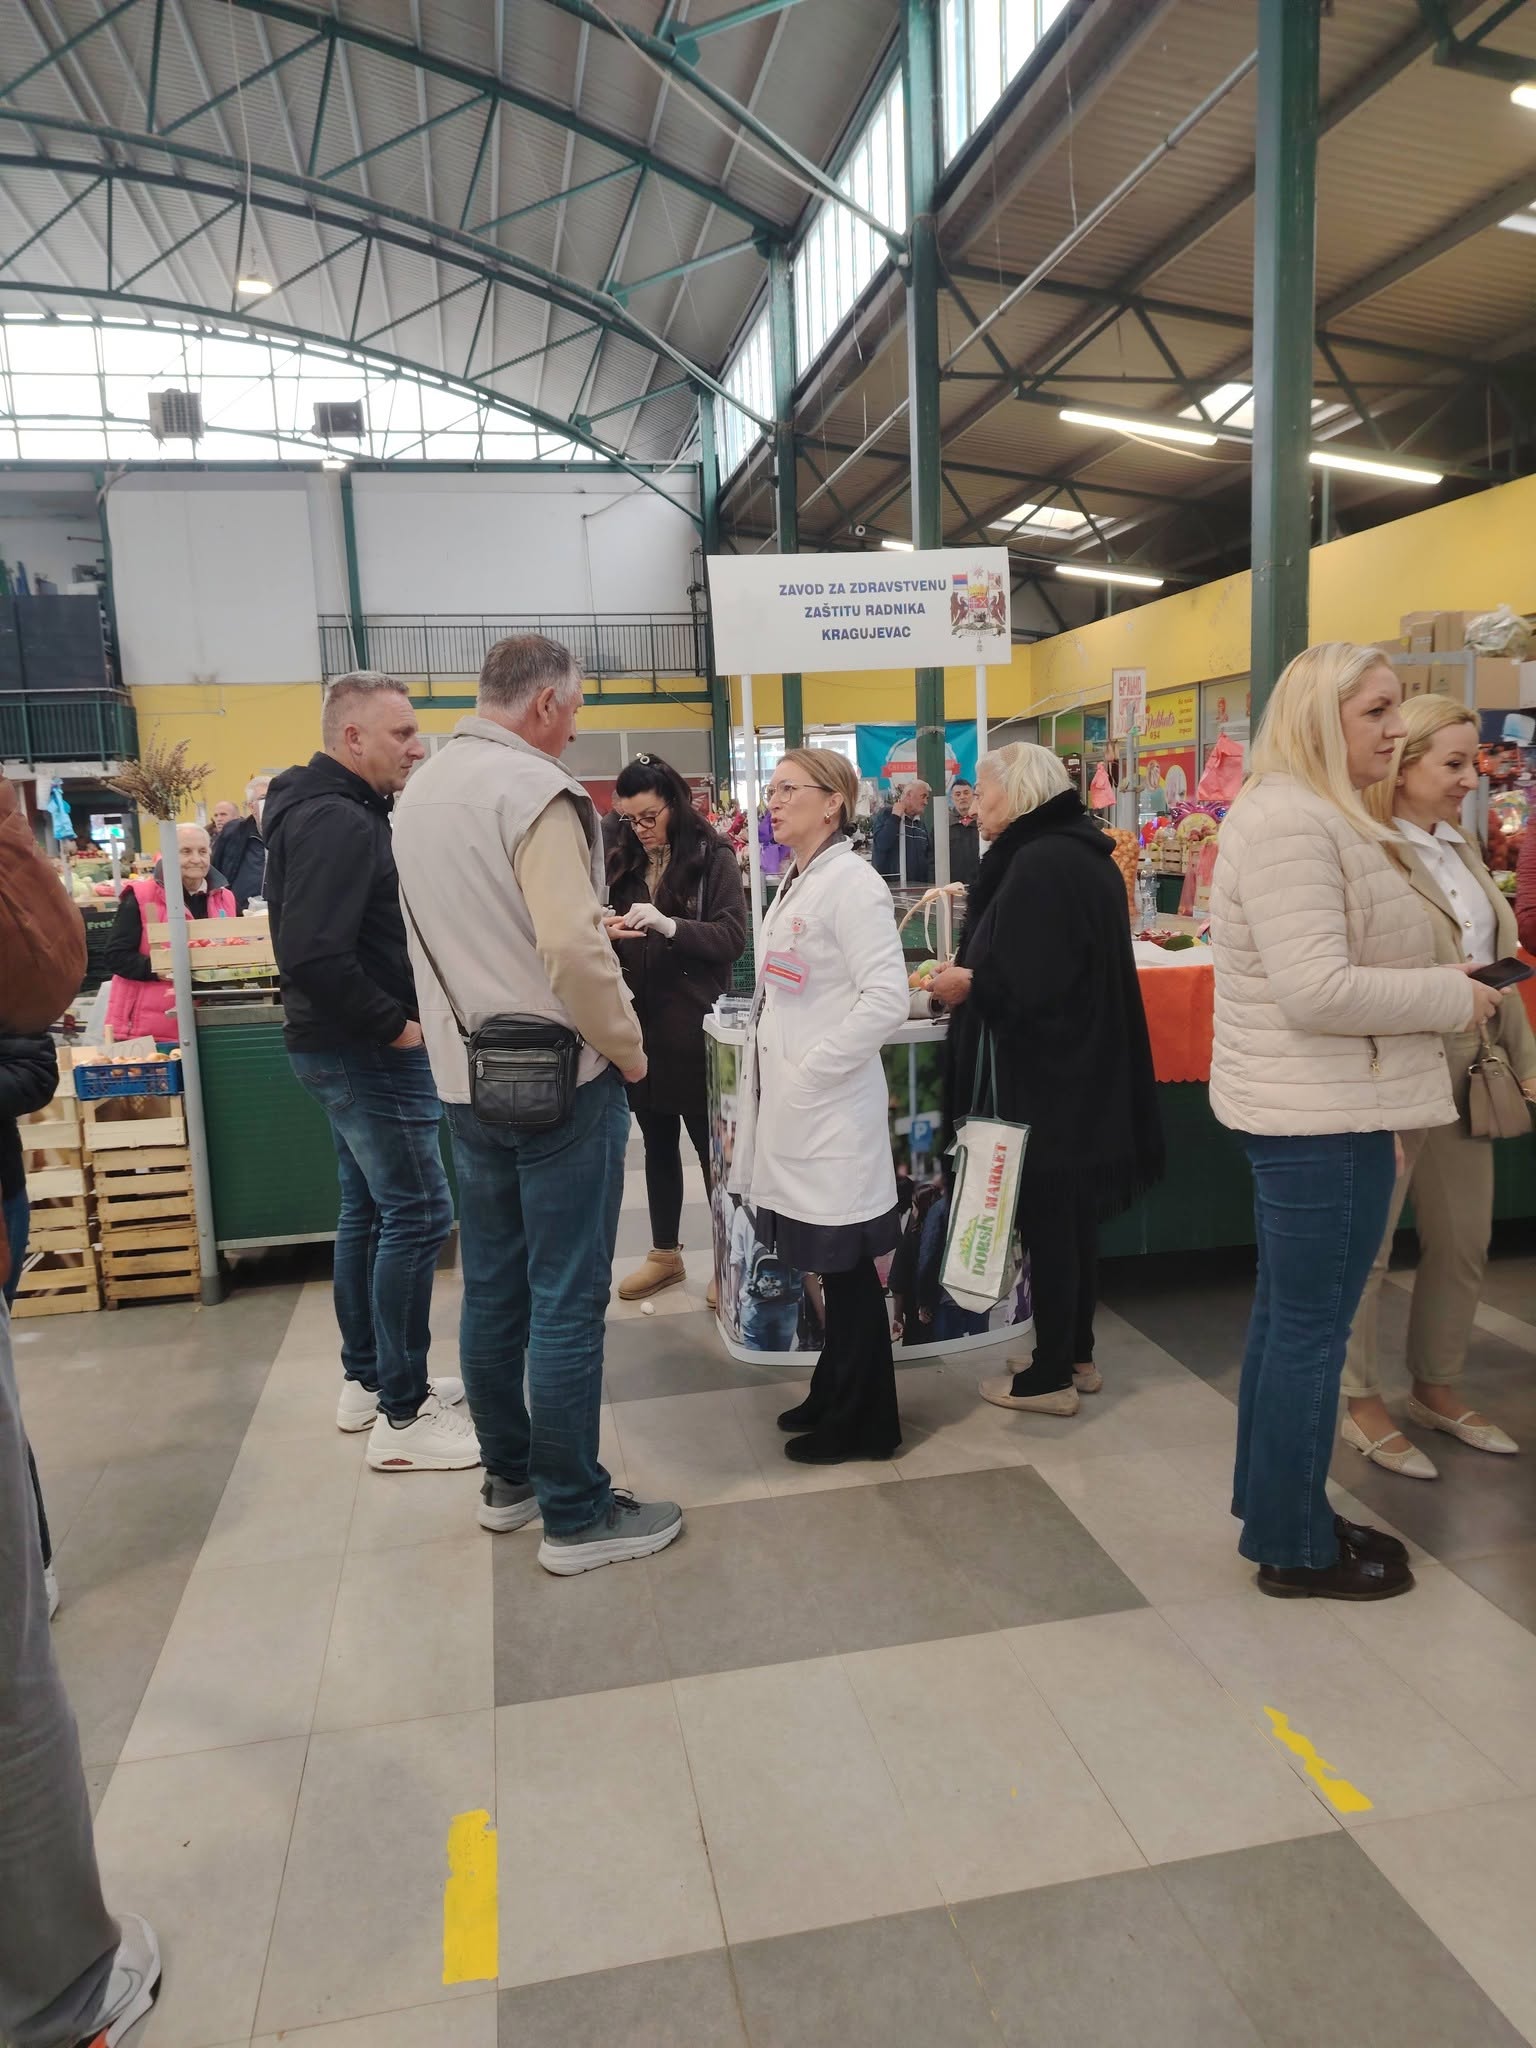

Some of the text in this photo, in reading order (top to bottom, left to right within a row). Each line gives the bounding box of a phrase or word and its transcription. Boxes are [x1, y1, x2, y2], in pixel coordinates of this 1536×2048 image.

[779, 579, 947, 596] ZAVOD ZA ZDRAVSTVENU
[804, 602, 926, 618] ZAŠTITU RADNIKA
[822, 625, 911, 641] KRAGUJEVAC
[984, 1143, 1008, 1210] MARKET
